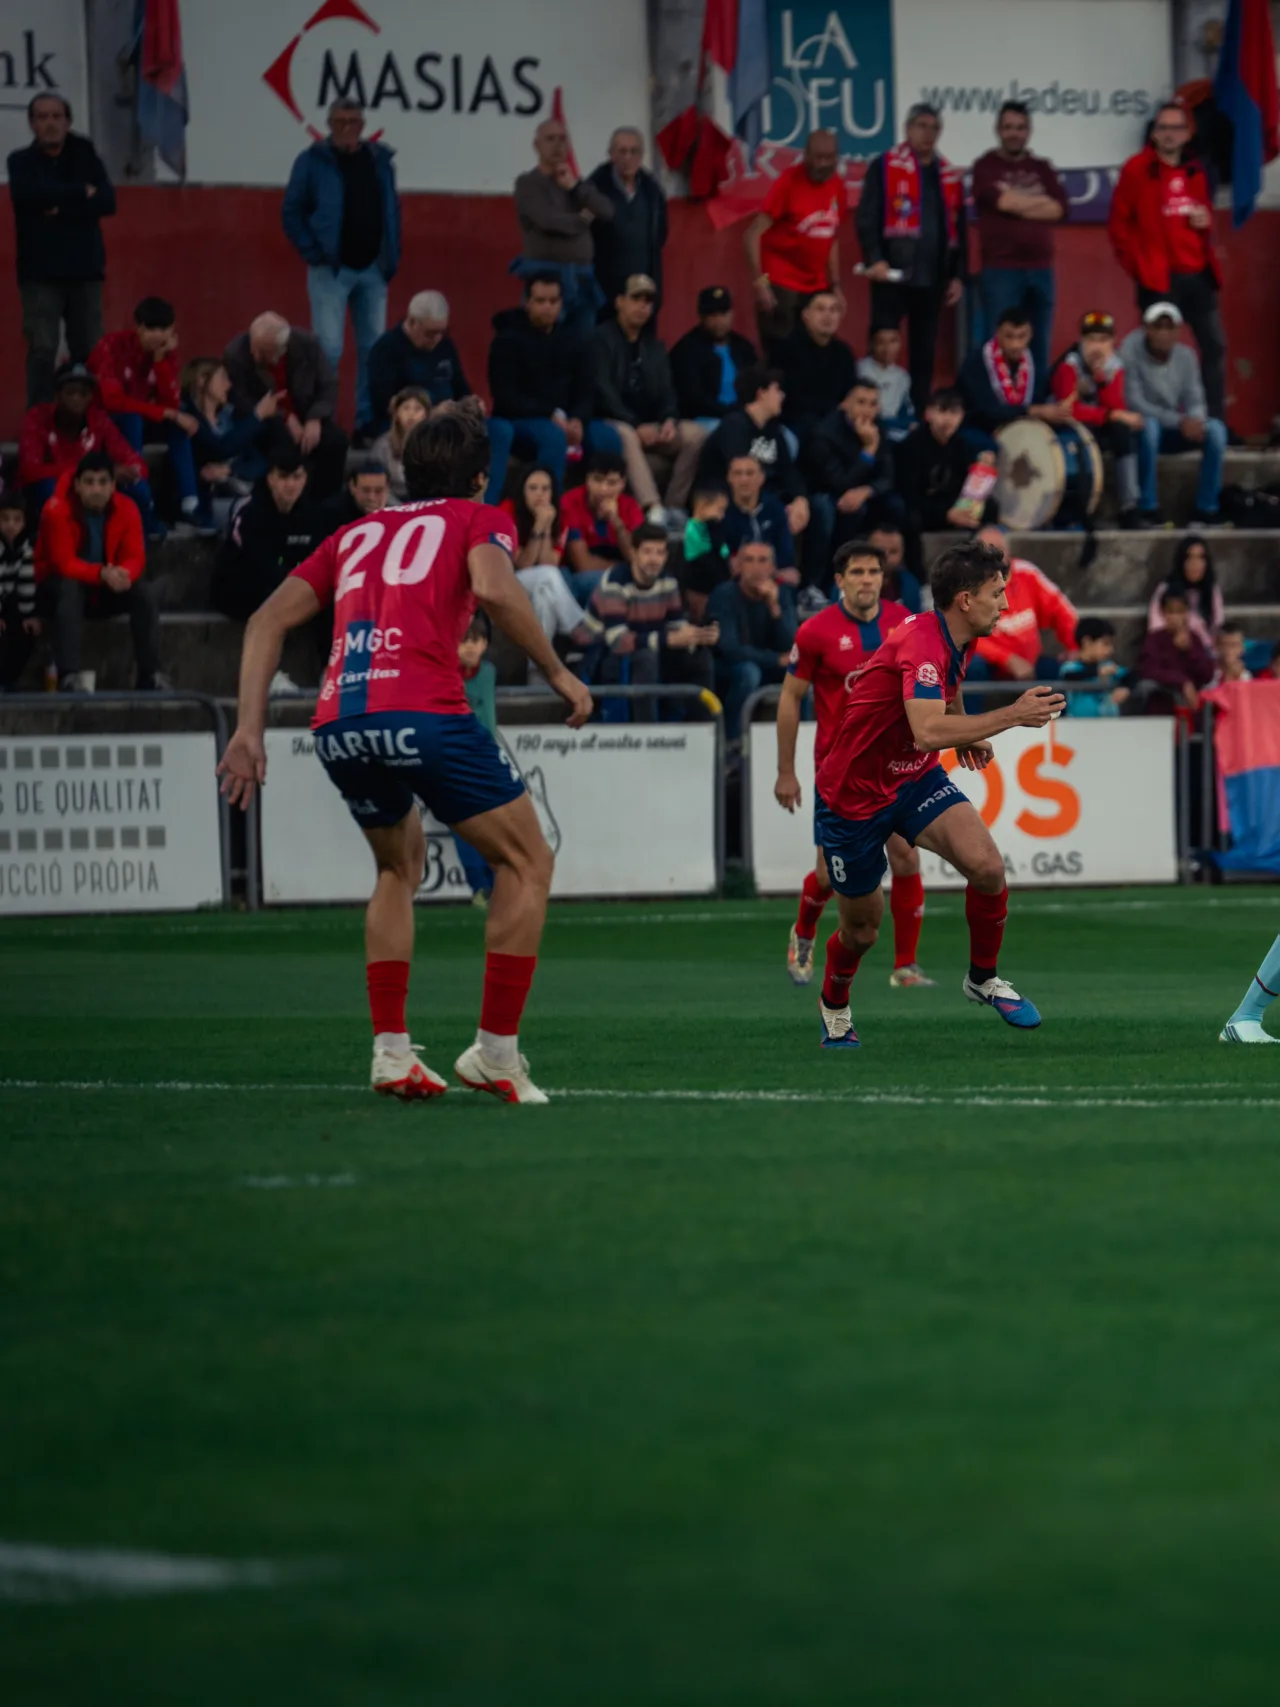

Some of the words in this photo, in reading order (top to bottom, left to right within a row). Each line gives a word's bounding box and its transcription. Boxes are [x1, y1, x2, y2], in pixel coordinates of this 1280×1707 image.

[781, 9, 859, 70] LA
[317, 49, 543, 116] MASIAS
[920, 79, 1150, 116] wwwladeu.es
[333, 514, 448, 602] 20
[343, 626, 404, 657] MGC
[15, 779, 45, 815] DE
[55, 776, 163, 818] QUALITAT
[0, 856, 62, 897] CCIÓ
[73, 856, 160, 895] PRÒPIA
[830, 855, 847, 883] 8
[1031, 851, 1083, 876] GAS
